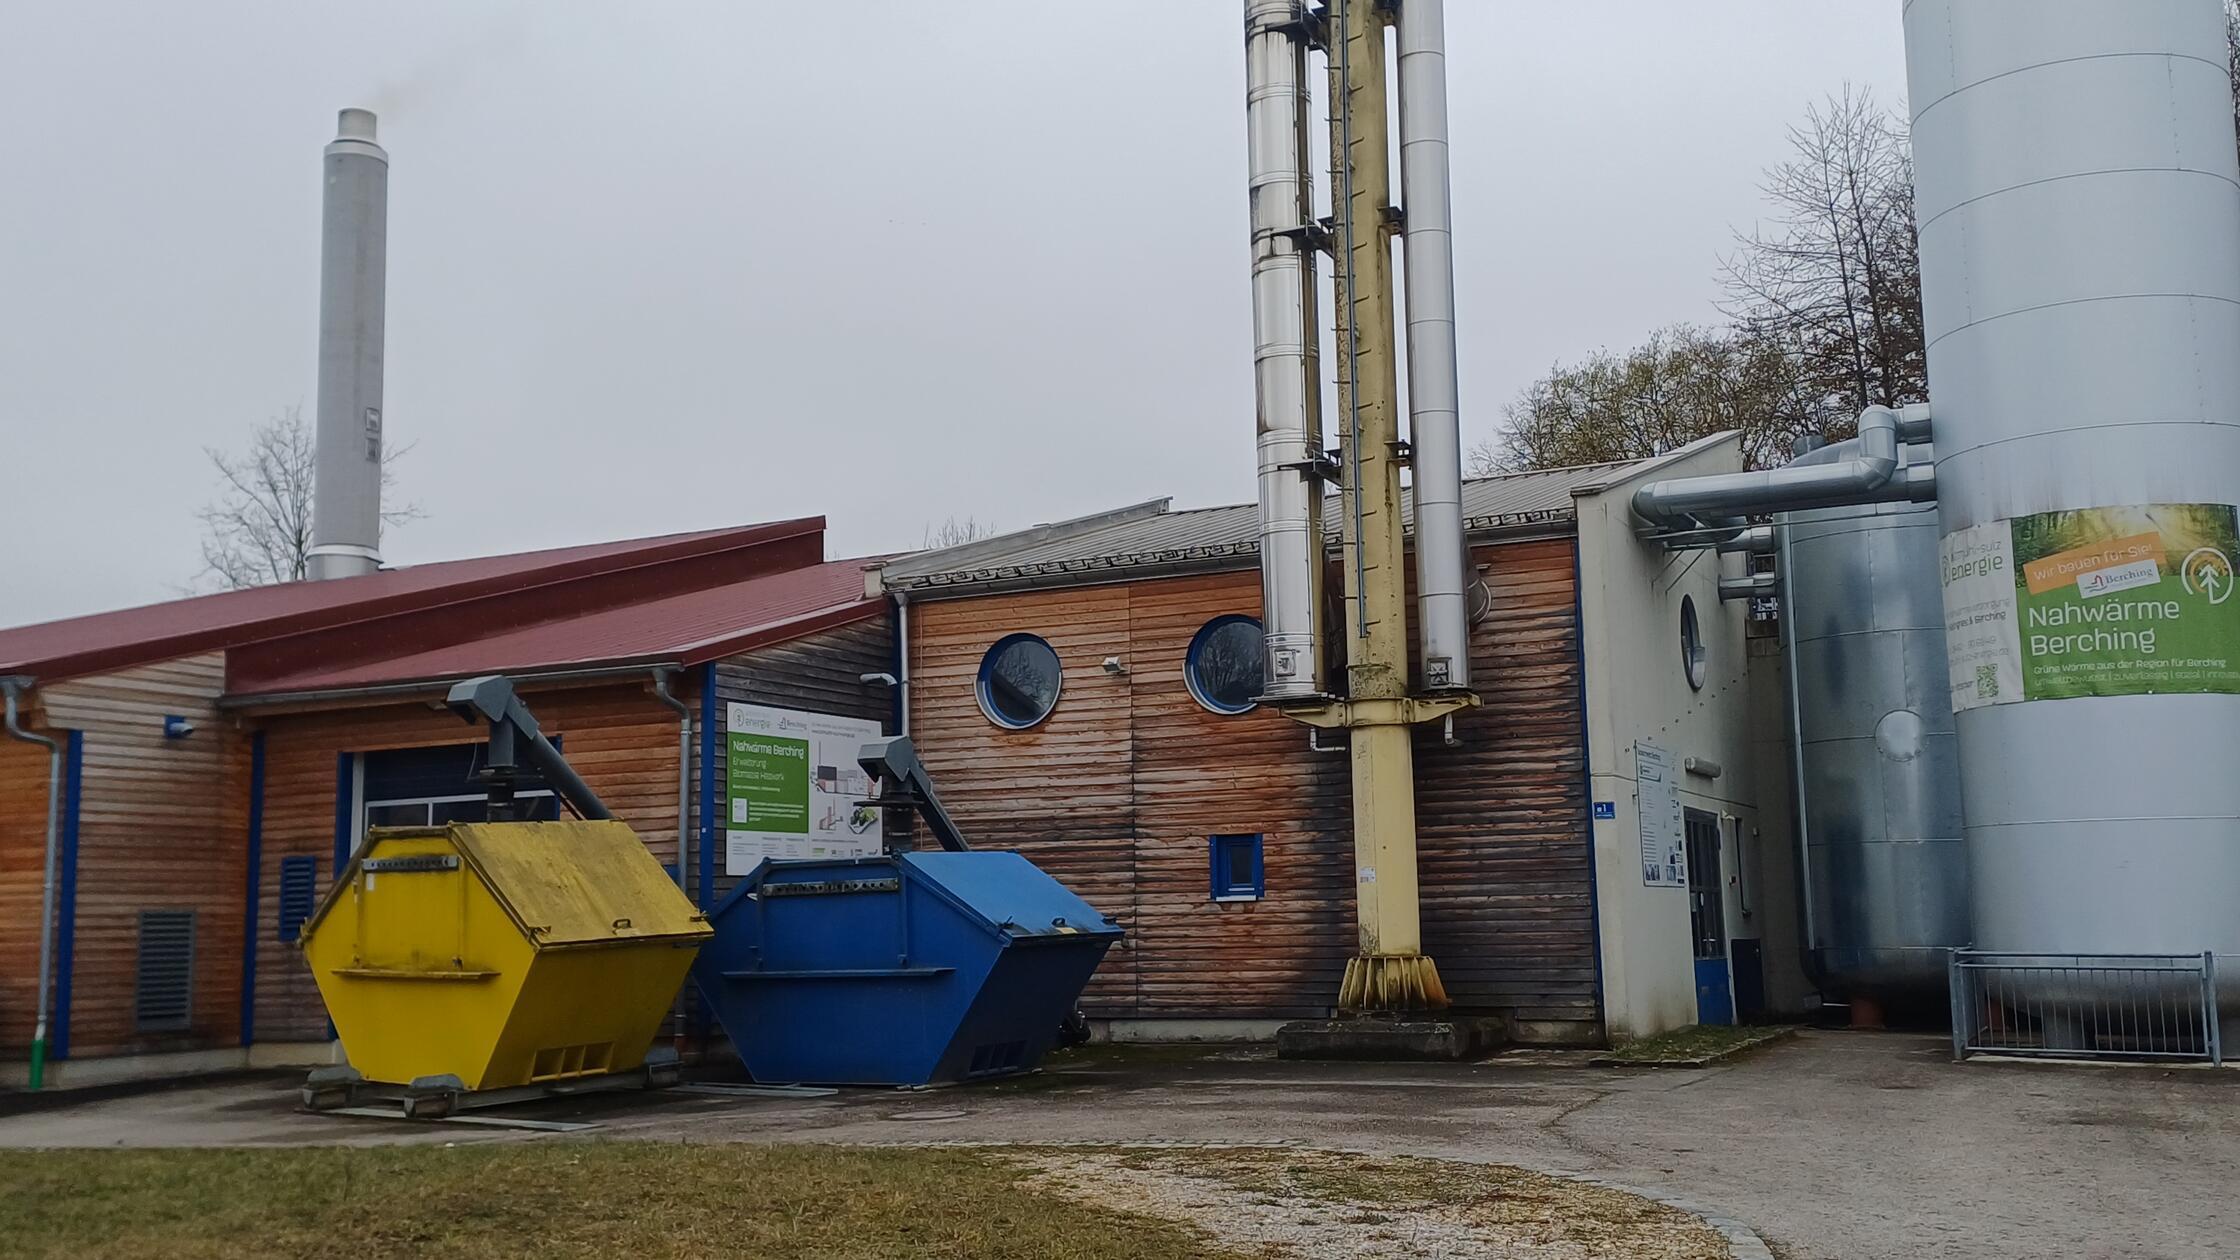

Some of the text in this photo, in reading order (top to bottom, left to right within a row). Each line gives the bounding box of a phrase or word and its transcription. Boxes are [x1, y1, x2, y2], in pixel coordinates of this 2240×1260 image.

[1951, 554, 2003, 581] energie
[2033, 544, 2153, 580] Wir bauen für Sie!
[2105, 567, 2153, 585] Berching
[2028, 598, 2180, 628] Nahwärme
[2030, 628, 2155, 656] Berching
[2034, 658, 2226, 675] Grüne Wärme aus der Region für Berching
[732, 741, 804, 760] Nahwärme Berching
